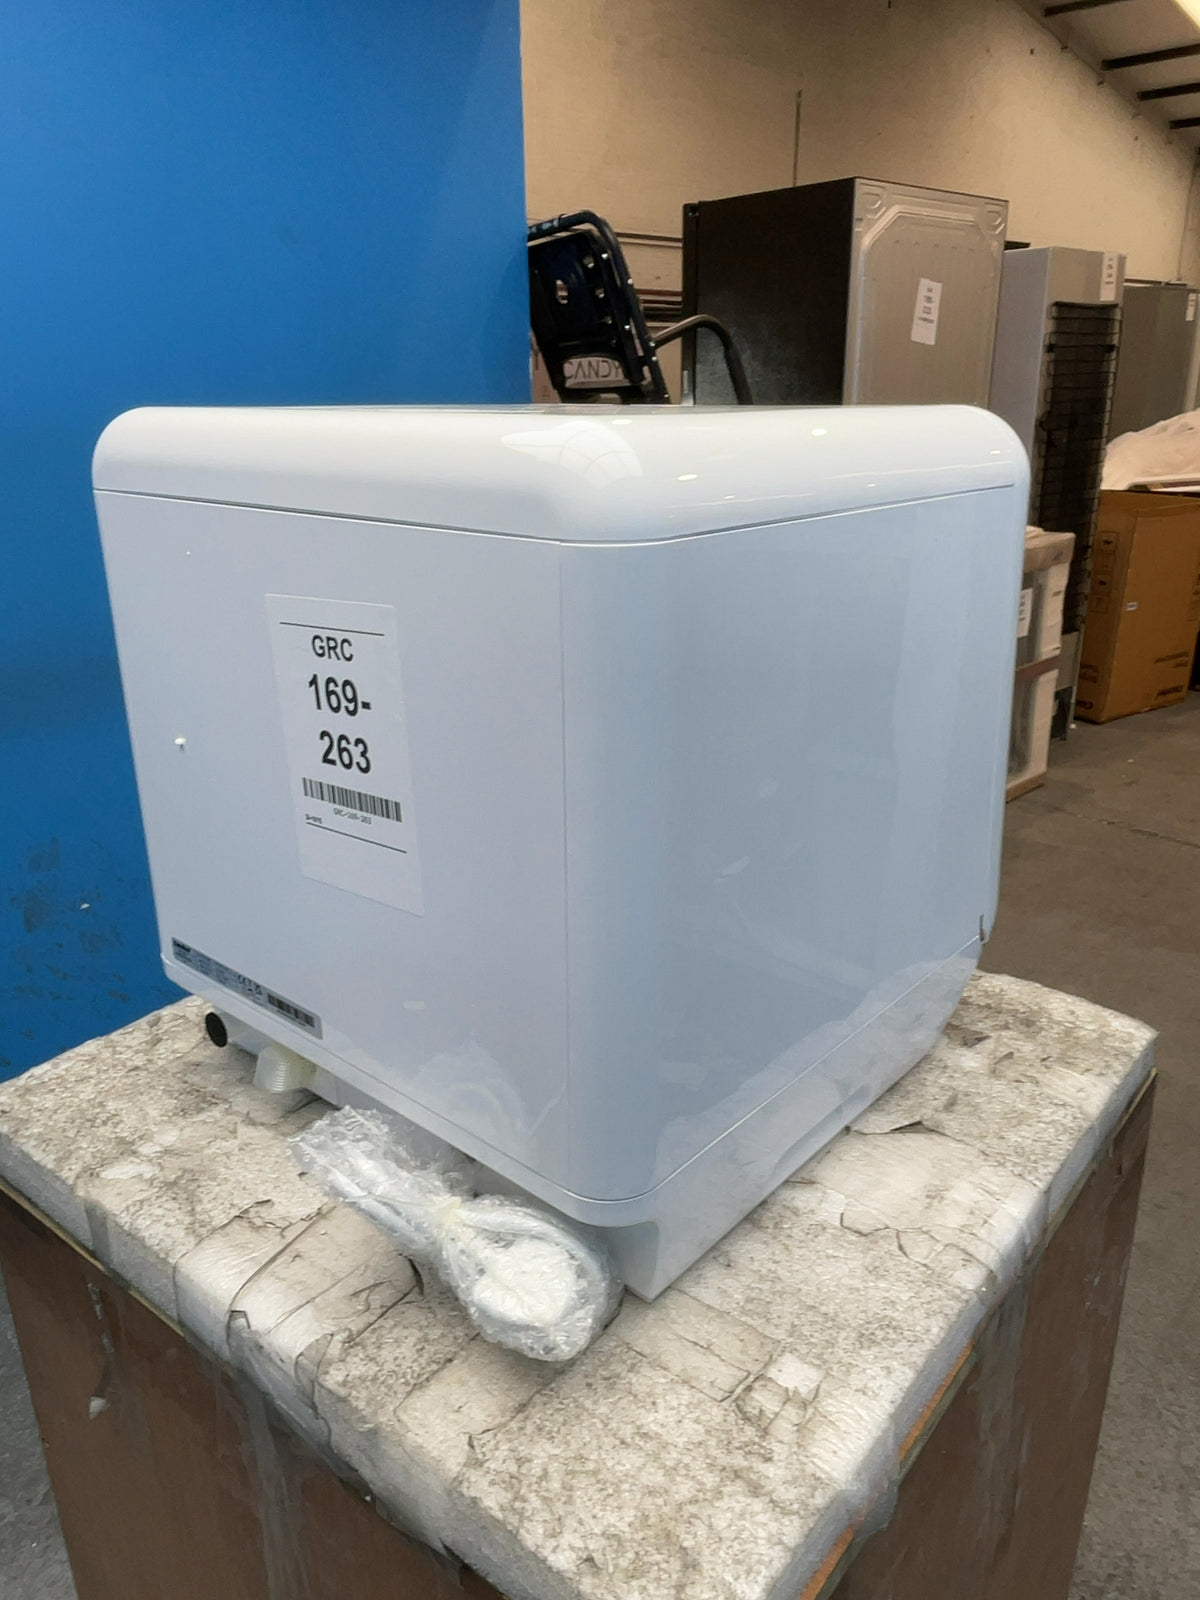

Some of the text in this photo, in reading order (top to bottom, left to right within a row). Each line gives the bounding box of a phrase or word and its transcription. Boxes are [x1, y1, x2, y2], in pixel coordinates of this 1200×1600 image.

[312, 635, 354, 662] GRC
[308, 674, 372, 717] 169-
[319, 730, 371, 774] 263
